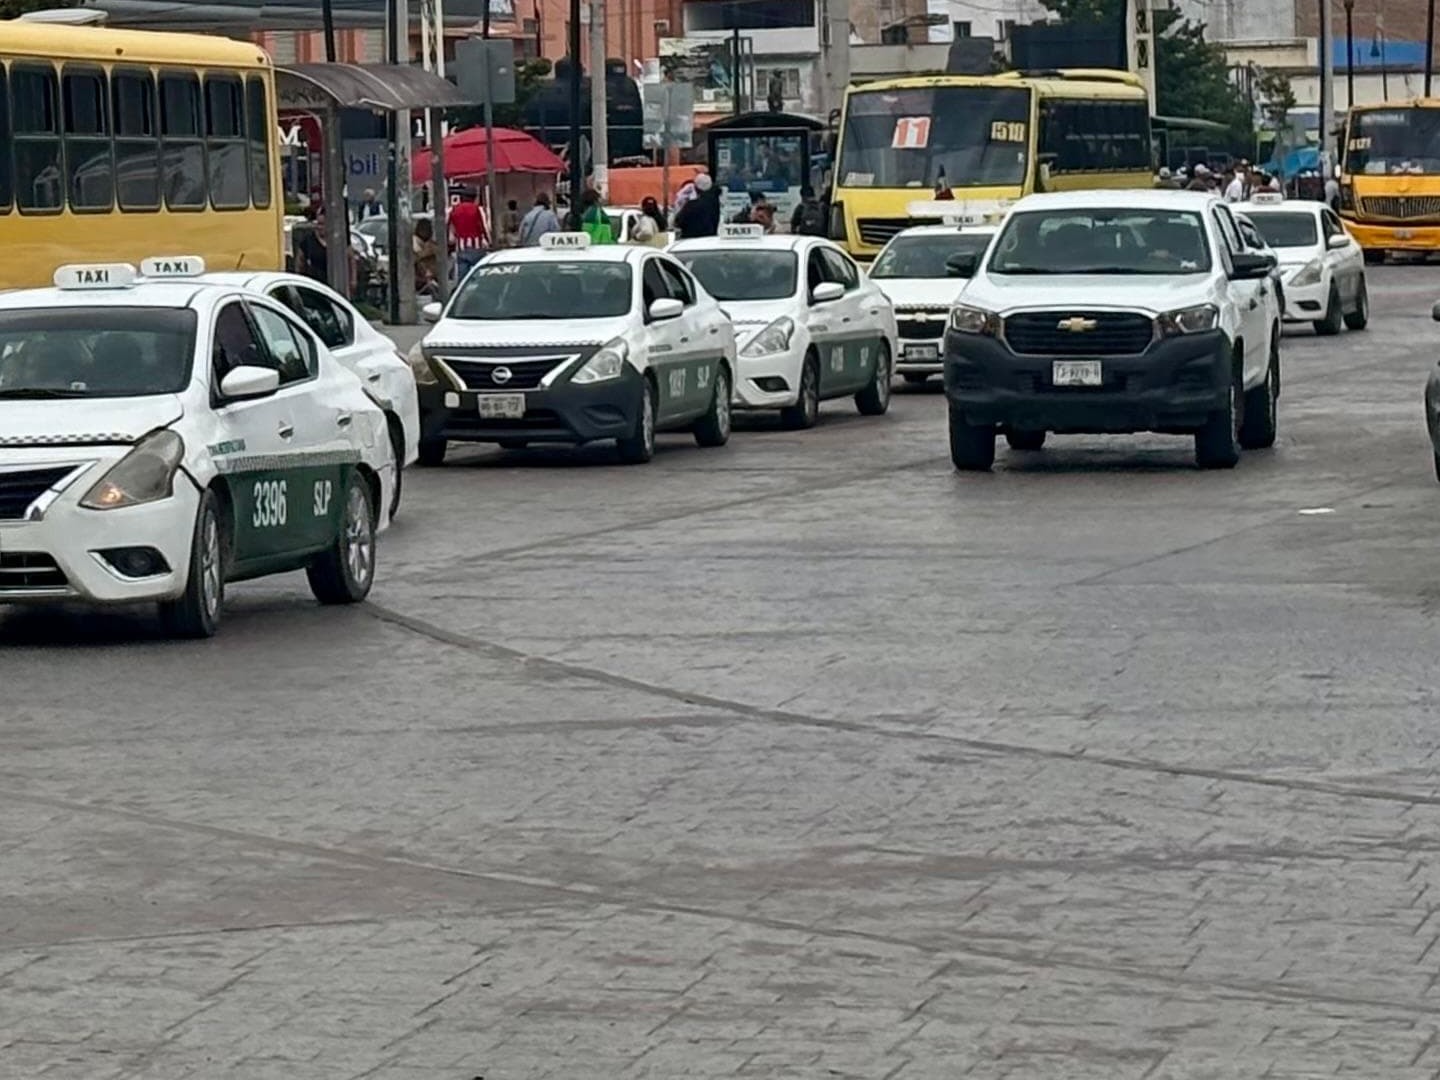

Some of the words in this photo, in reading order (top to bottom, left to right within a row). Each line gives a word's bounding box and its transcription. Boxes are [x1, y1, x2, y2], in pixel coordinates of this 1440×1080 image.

[893, 118, 929, 148] 11
[726, 227, 752, 235] TAXI
[550, 236, 579, 246] TAXI
[153, 262, 189, 273] TAXI
[479, 265, 520, 276] TAXI
[76, 270, 109, 283] TAXI
[253, 480, 288, 528] 3396
[313, 480, 332, 517] SLP
